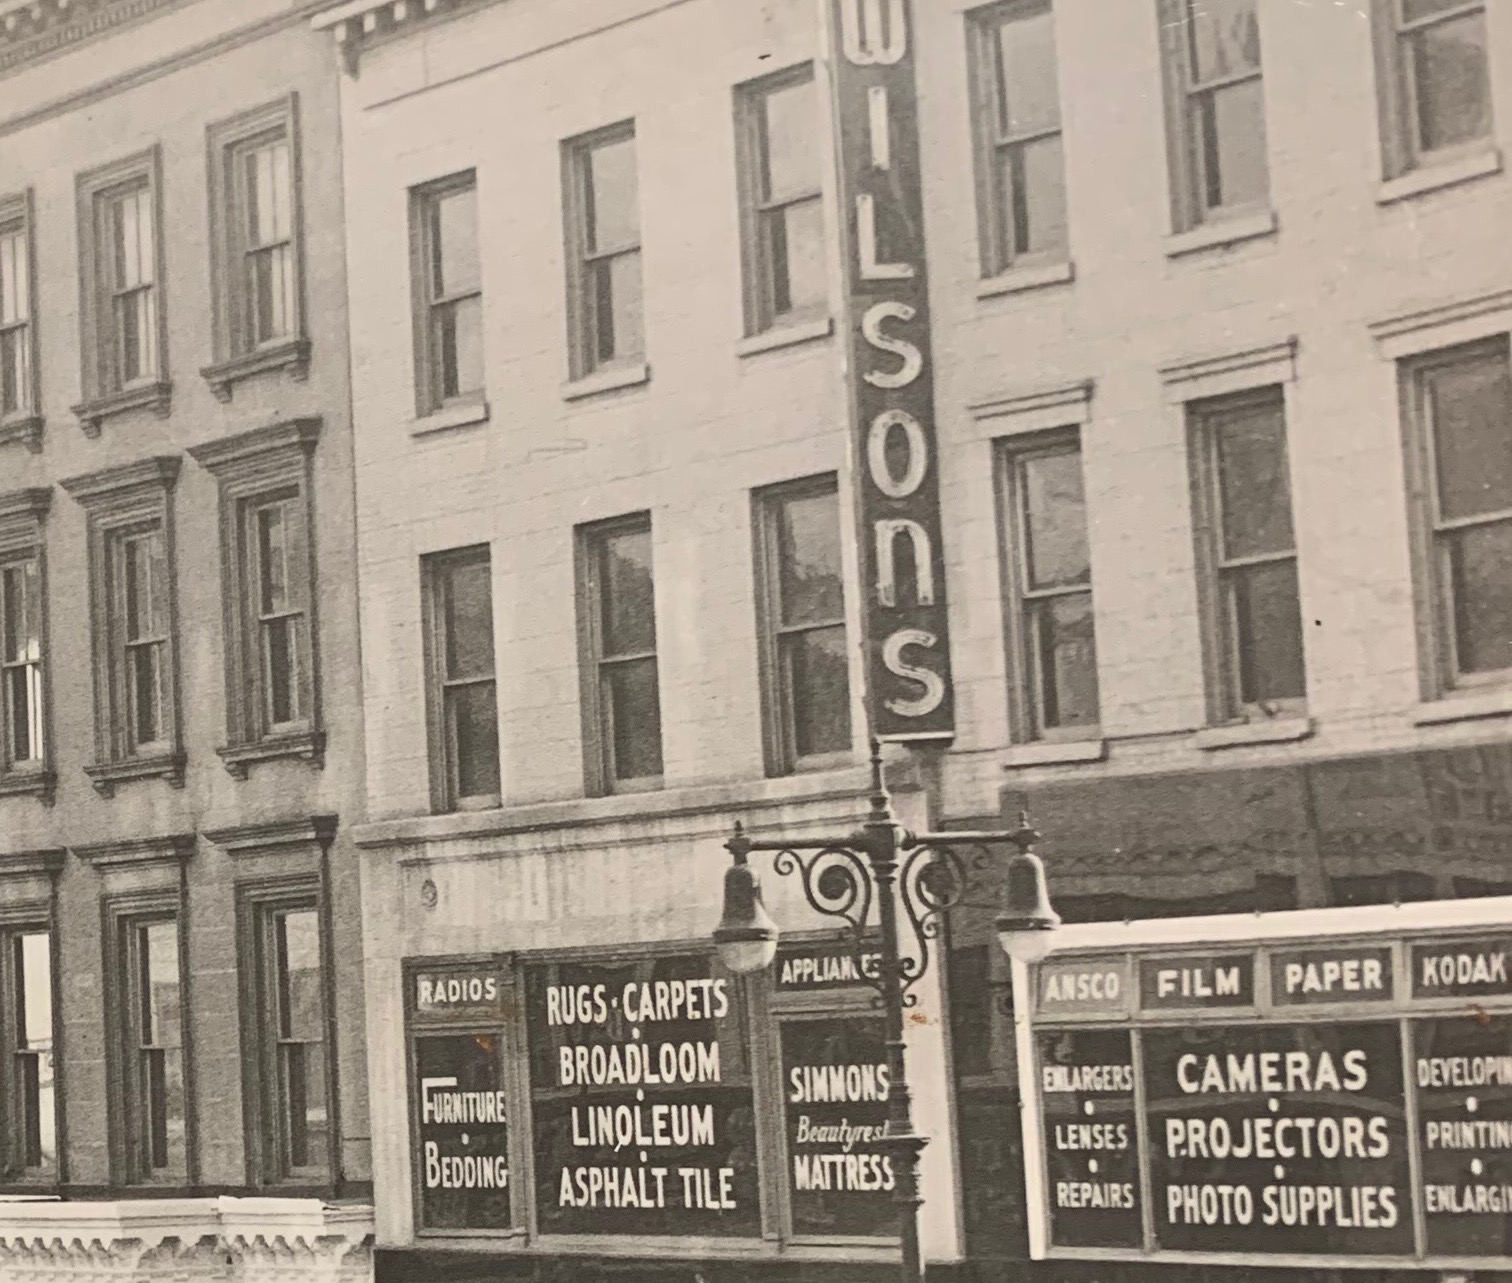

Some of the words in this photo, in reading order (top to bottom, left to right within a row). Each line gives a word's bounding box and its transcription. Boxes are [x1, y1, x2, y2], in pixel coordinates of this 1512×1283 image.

[1044, 971, 1119, 1002] ANSCO
[1157, 966, 1241, 998] FILM
[1285, 960, 1383, 993] PAPER
[1421, 952, 1509, 988] KODAK
[419, 978, 497, 1005] RADIOS
[547, 985, 608, 1026] RUGS
[622, 979, 729, 1020] CARPETS
[559, 1042, 720, 1086] BROADLOOM
[791, 1064, 889, 1103] SIMMONS
[1043, 1065, 1133, 1093] ENLARGERS
[1176, 1050, 1369, 1093] CAMERAS
[421, 1077, 506, 1126] FURNITURE
[571, 1104, 715, 1149] LINOLEUM
[1055, 1124, 1128, 1150] LENSES
[1165, 1117, 1390, 1158] PROJECTORS
[425, 1141, 509, 1189] BEDDING
[794, 1154, 896, 1191] MATTRESS
[558, 1167, 670, 1209] ASPHALT
[678, 1167, 737, 1209] TILE
[1056, 1182, 1134, 1210] REPAIRS
[1167, 1184, 1253, 1225] PHOTO
[1262, 1185, 1398, 1228] SUPPLIES
